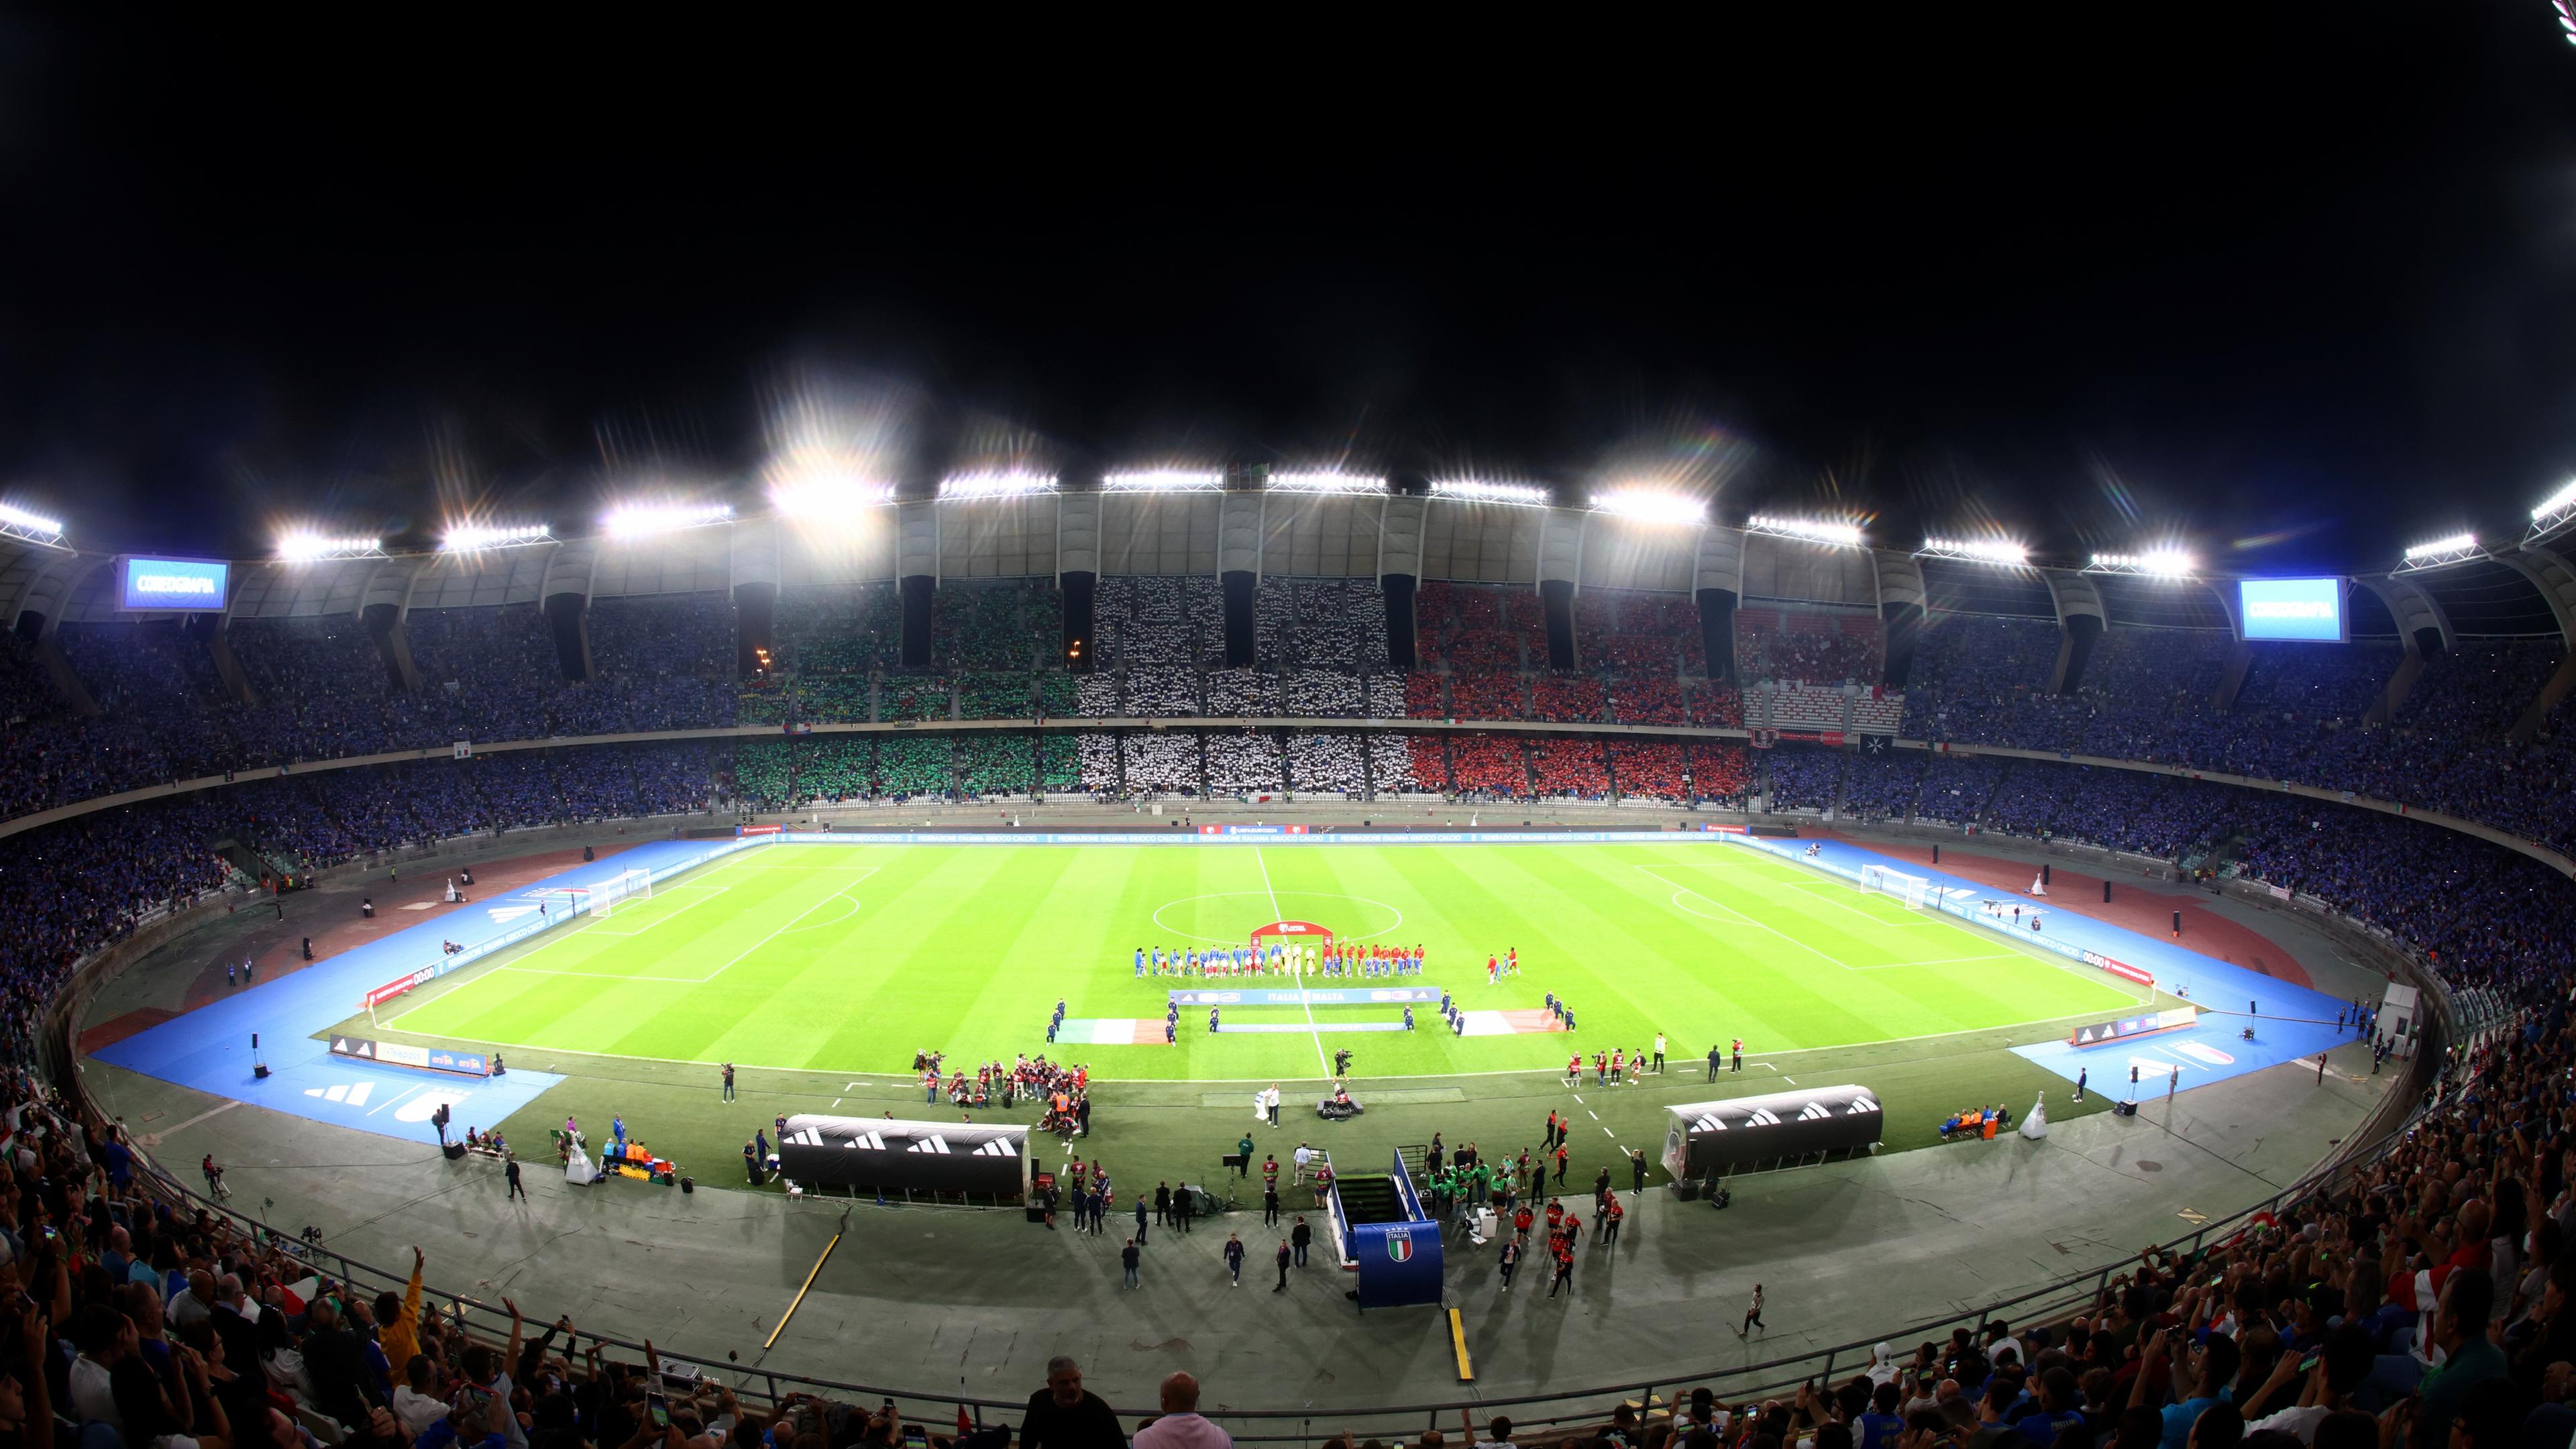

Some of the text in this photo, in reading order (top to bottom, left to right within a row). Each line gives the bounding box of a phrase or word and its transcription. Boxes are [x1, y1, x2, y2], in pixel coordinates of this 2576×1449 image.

[137, 575, 215, 593] COREOGRAFIA
[527, 919, 546, 934] CALCIO
[2056, 942, 2079, 957] CALCIO
[2083, 951, 2104, 967] 00:00
[413, 967, 435, 985] 00:00
[1269, 993, 1299, 1001] ITALIA
